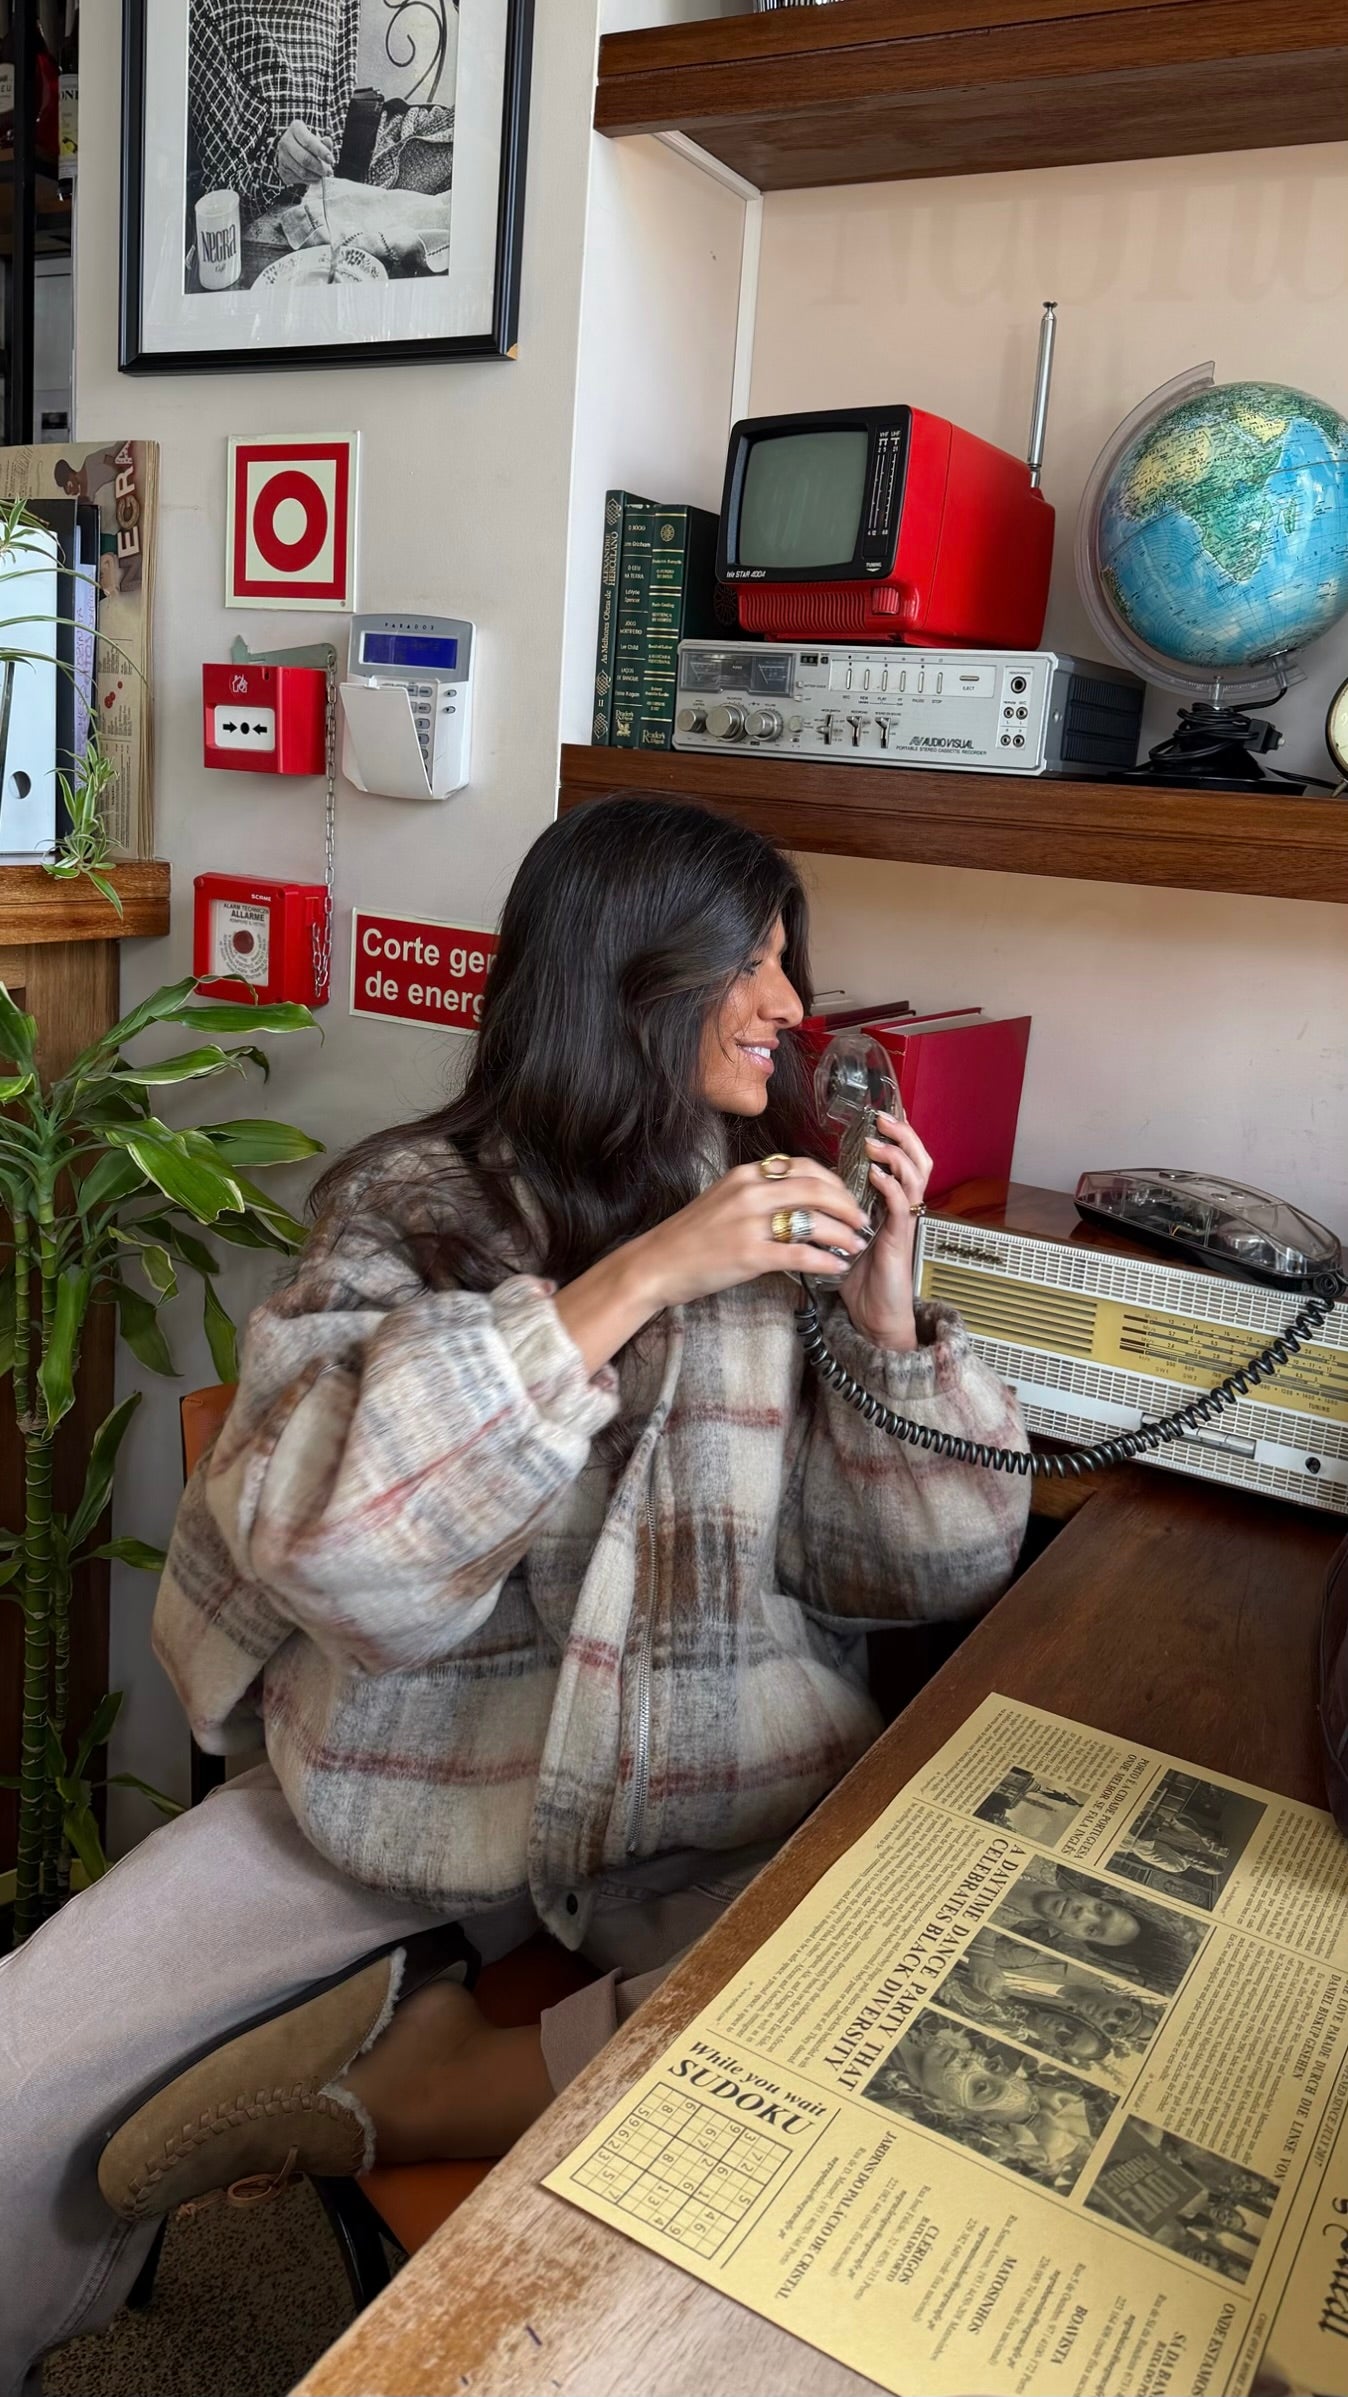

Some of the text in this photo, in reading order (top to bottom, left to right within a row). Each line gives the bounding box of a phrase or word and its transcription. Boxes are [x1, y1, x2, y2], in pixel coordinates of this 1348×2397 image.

[200, 223, 237, 263] NEGRA
[114, 440, 142, 592] NEGRA
[609, 531, 619, 586] HERCULANO
[735, 570, 750, 578] STAR
[603, 590, 612, 599] de
[603, 600, 611, 620] Obras
[384, 622, 435, 631] PARADOX
[601, 622, 610, 652] Melhores
[231, 909, 265, 922] ALLARME
[363, 928, 440, 966] Corte
[365, 971, 399, 1000] de
[1129, 1758, 1149, 1779] PORTO
[1061, 1754, 1136, 1854] ONDE MELHOR SE FALA INGLÊS
[1104, 1789, 1127, 1815] CIDADE
[1074, 1814, 1110, 1858] PORTUGUESA
[824, 1838, 1008, 2070] CELEBRATES BLACK DIVERSITY
[837, 1844, 1025, 2091] A DAYTIME DANCE PARTY THAT
[1292, 1974, 1341, 2080] DANIEL BISKUP GESEHEN
[668, 2059, 811, 2133] SUDOKU
[689, 2041, 826, 2115] While you wait
[1274, 1998, 1347, 2178] LOVE PARADE DURCH DIE LINSE VON
[1314, 2095, 1342, 2167] SINCE JULY 2017
[775, 2131, 896, 2298] JARDINS DO PALÁCIO DE CRISTAL
[1118, 2168, 1188, 2224] LOVE
[886, 2216, 929, 2281] BAIXA DO PORTO
[898, 2225, 938, 2284] CLÉRIGOS
[968, 2256, 1016, 2333] MATOSINHOS
[1050, 2305, 1087, 2363] BOAVISTA
[1161, 2349, 1179, 2367] DA
[1169, 2331, 1185, 2350] SÁ
[1192, 2303, 1235, 2395] ONDE ESTAMOS
